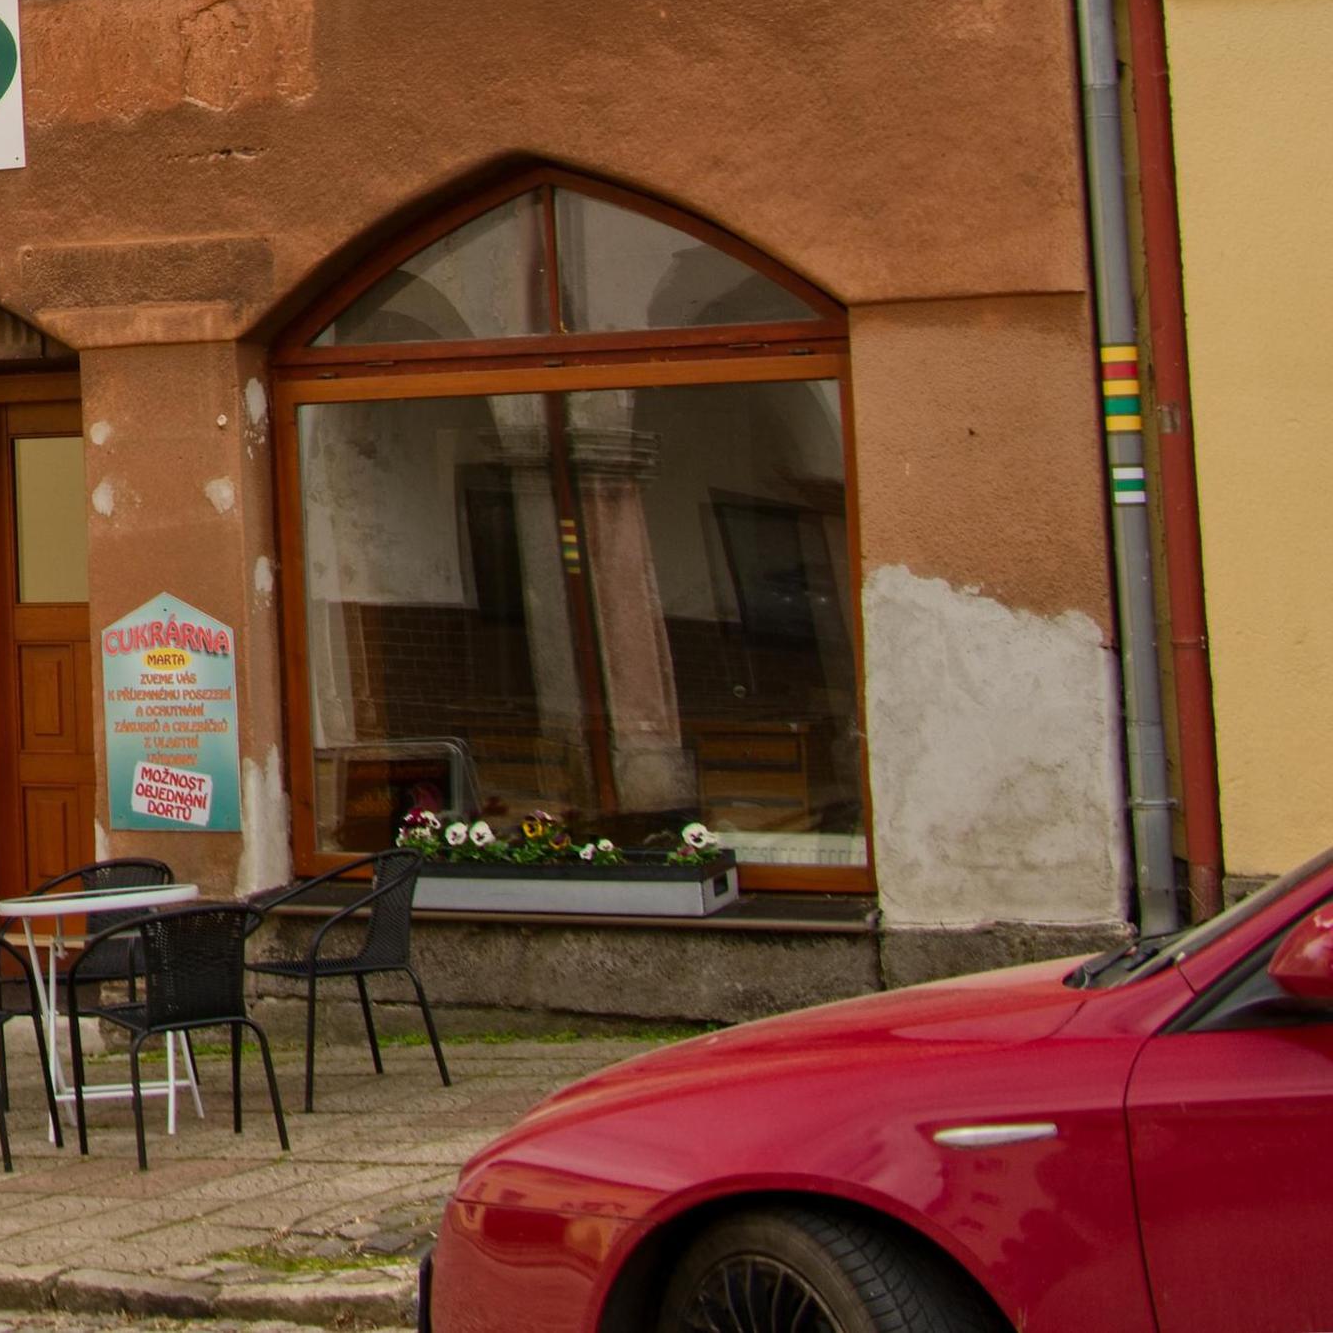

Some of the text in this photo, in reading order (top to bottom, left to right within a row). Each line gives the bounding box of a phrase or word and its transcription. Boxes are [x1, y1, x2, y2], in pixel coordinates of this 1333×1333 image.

[103, 612, 230, 657] CUKRÁRNA
[147, 654, 186, 666] MARTA
[140, 670, 197, 685] ZVEME VÁS
[141, 766, 206, 792] MOŽNOST
[135, 782, 208, 811] OBJEDNÁNÍ
